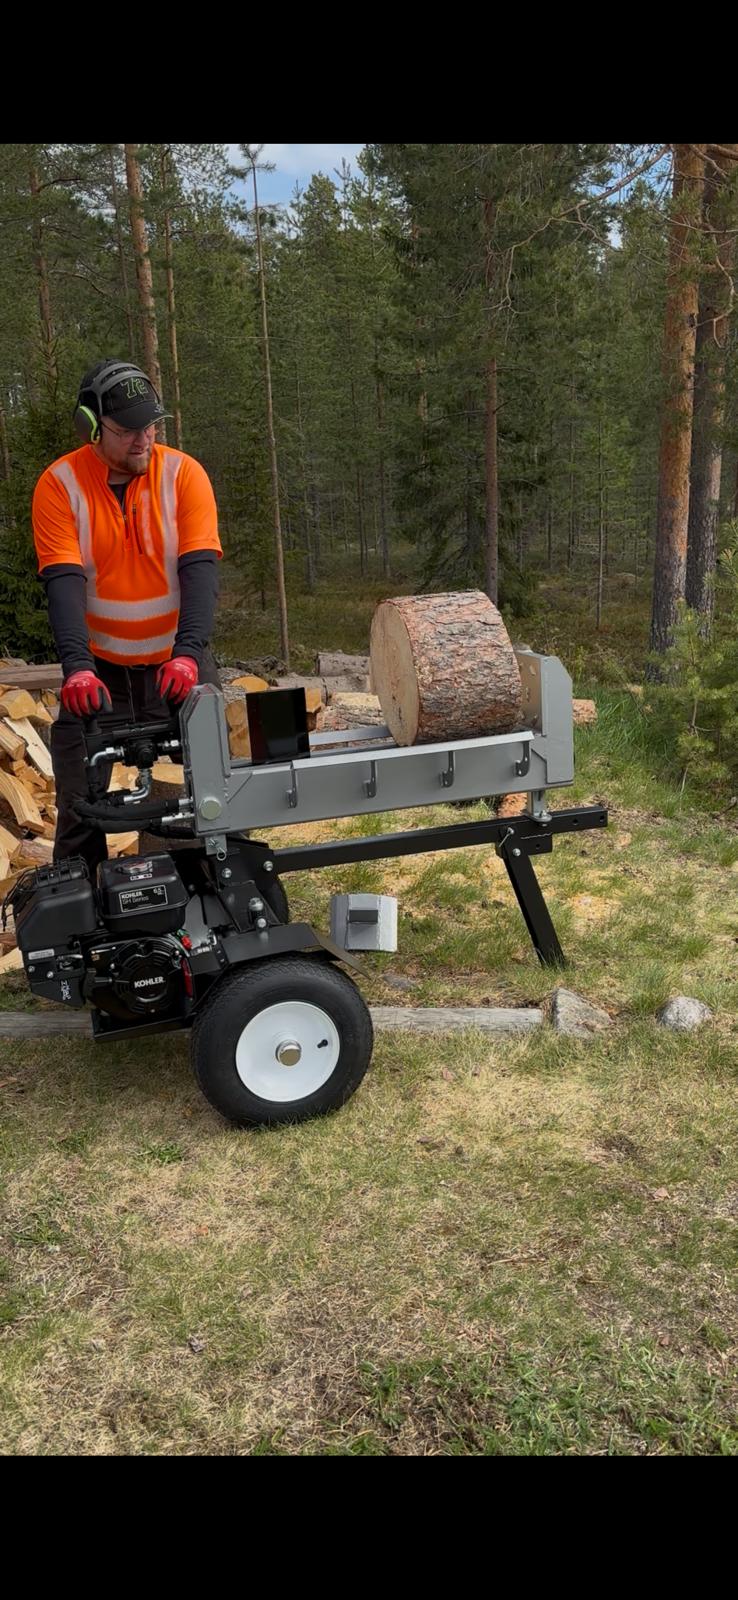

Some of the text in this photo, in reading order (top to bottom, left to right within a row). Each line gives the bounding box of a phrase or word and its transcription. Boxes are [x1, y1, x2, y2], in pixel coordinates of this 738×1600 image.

[120, 377, 149, 398] 72
[121, 891, 143, 899] KOHLER
[133, 976, 166, 988] KOHLER
